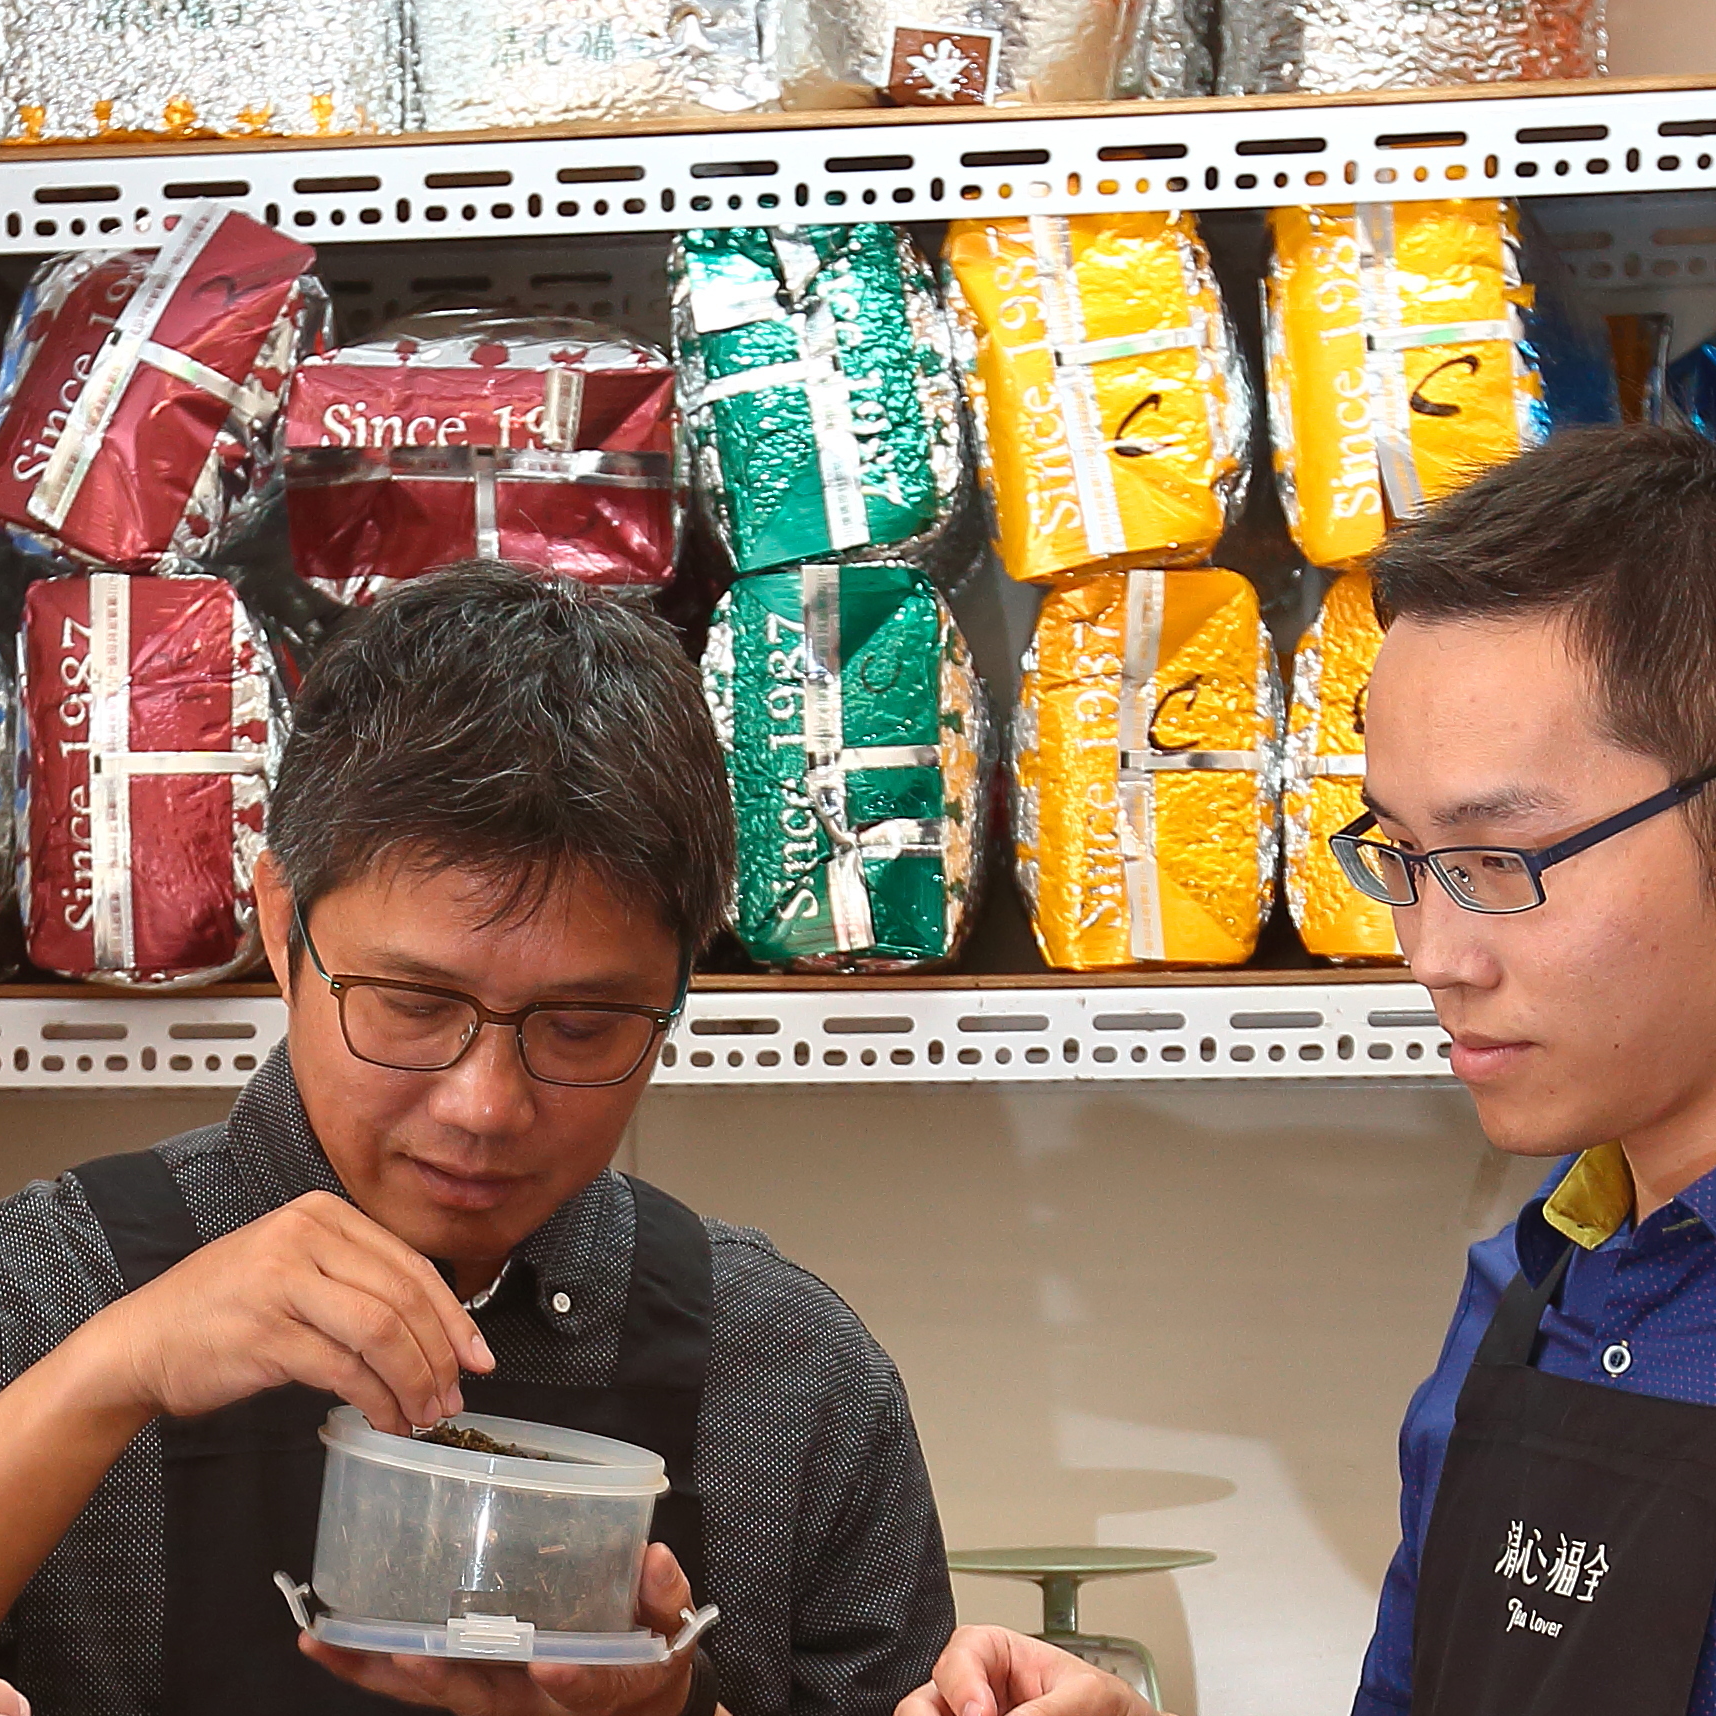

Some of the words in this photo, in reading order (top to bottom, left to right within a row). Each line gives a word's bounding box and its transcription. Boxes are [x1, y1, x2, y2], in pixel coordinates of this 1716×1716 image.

[320, 401, 468, 448] Since
[1022, 384, 1082, 538] Since
[1330, 367, 1383, 520] Since
